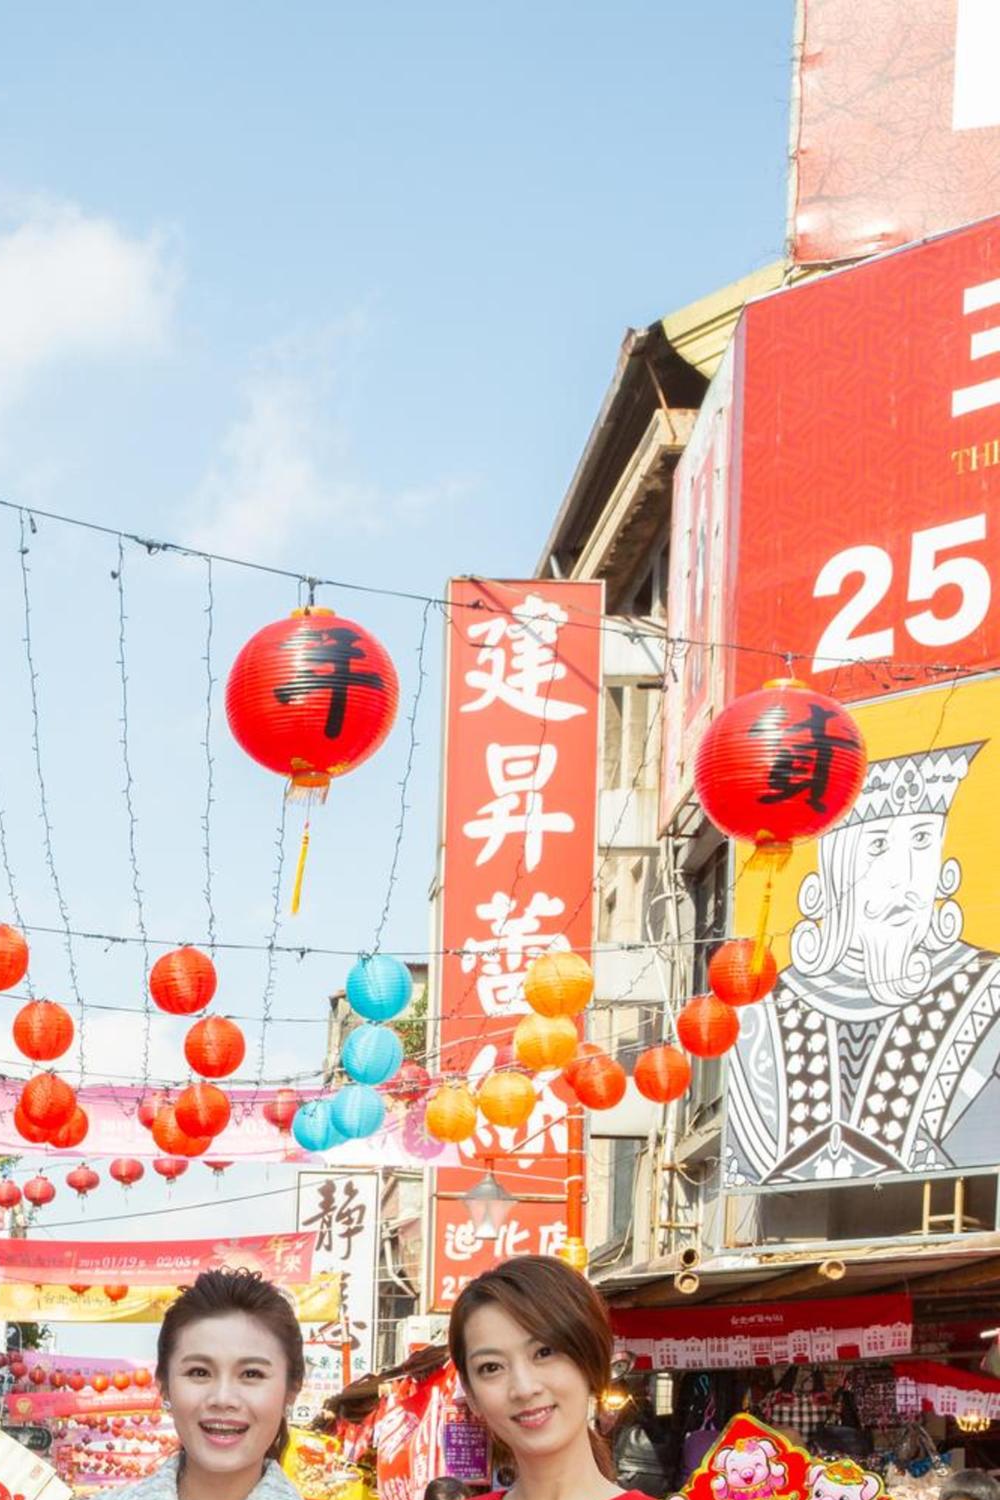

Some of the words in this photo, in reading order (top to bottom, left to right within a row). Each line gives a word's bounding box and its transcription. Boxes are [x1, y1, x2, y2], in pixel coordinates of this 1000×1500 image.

[811, 513, 991, 673] 25
[274, 627, 383, 740] 年
[747, 703, 860, 813] 貨
